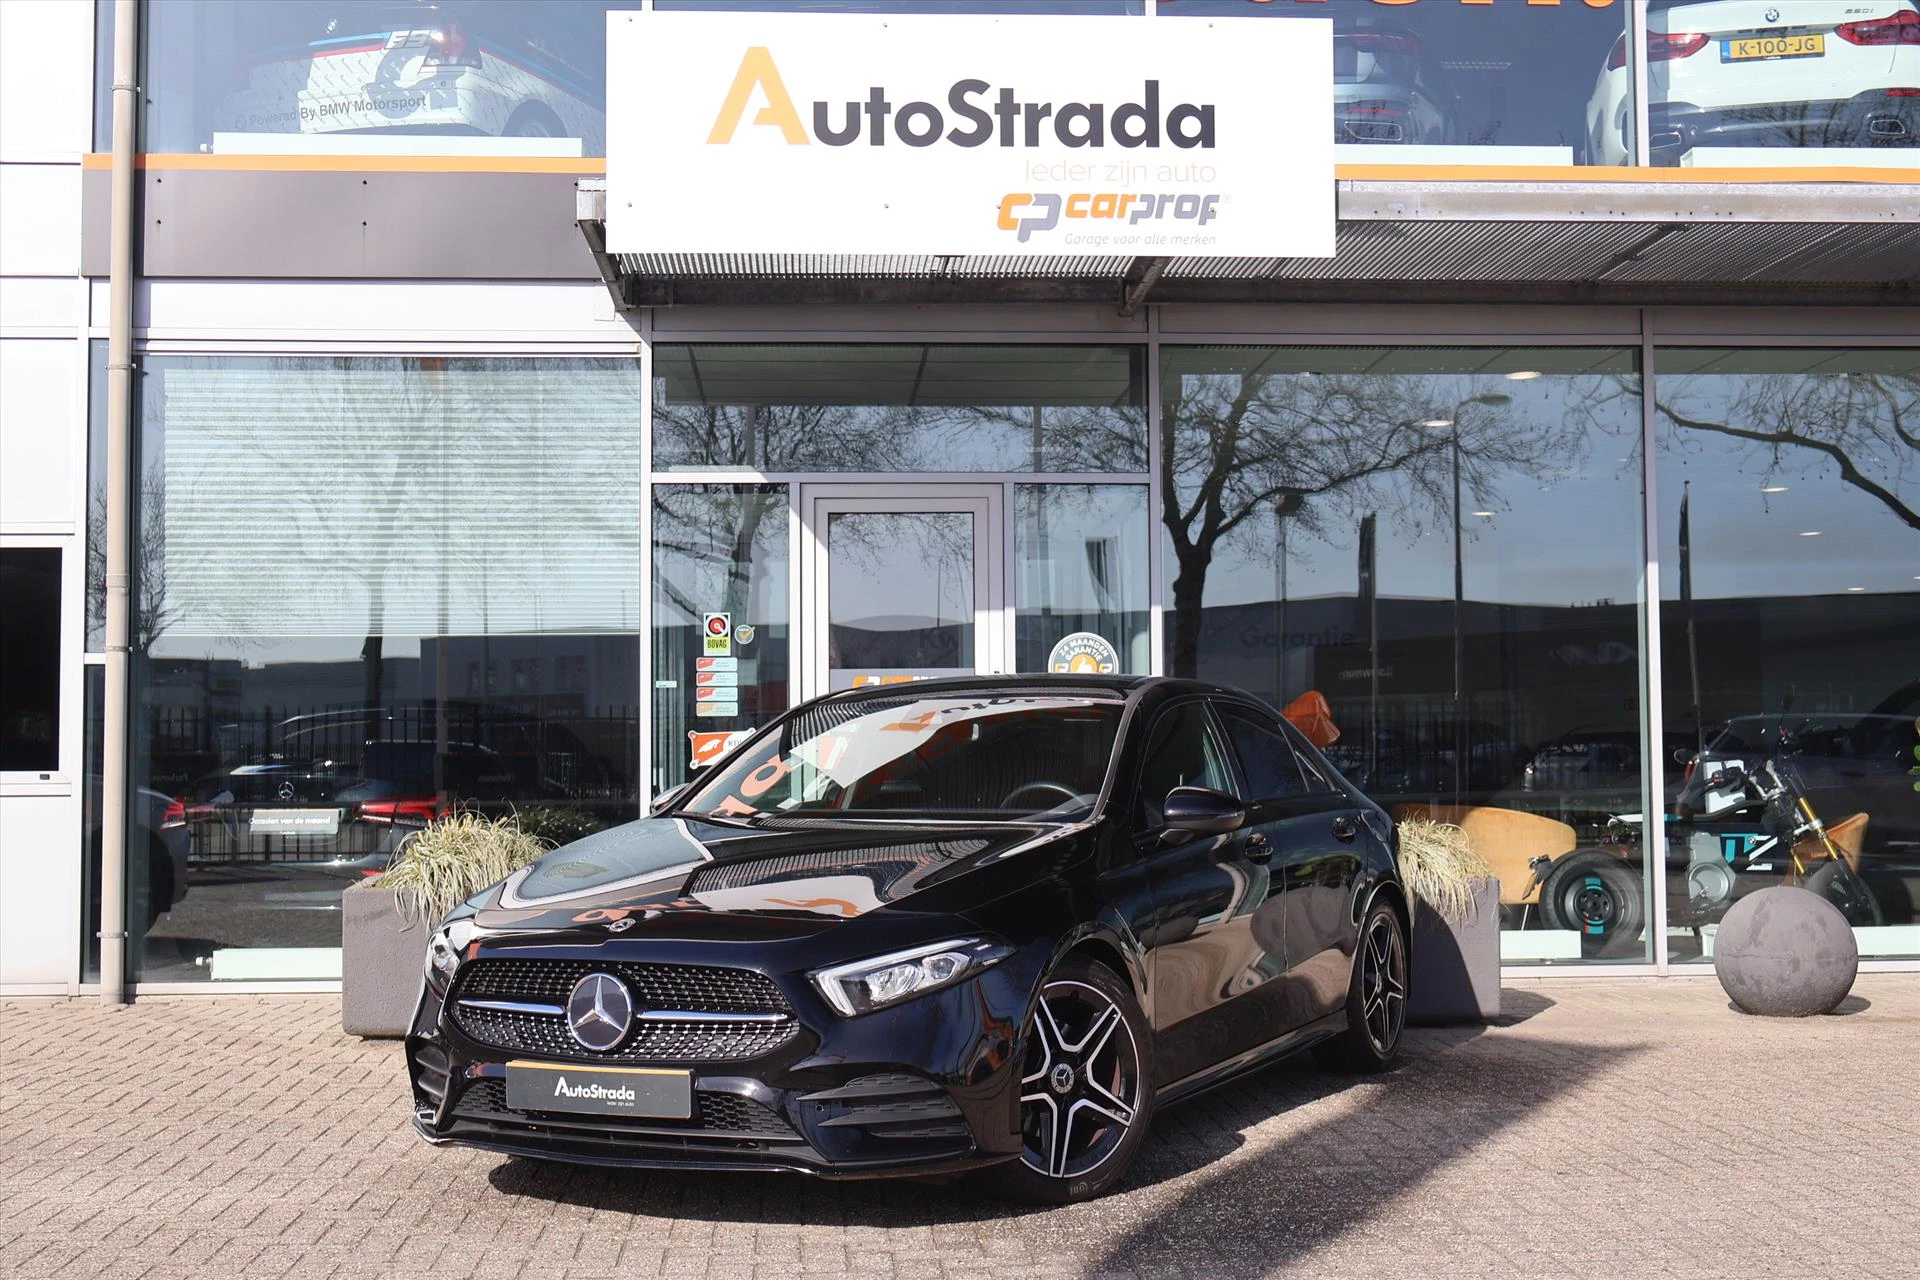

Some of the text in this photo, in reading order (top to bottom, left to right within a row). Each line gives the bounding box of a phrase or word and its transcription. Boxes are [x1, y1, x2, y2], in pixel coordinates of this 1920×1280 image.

[1738, 38, 1816, 56] K-100-JG
[708, 46, 1216, 149] AutoStrada
[250, 95, 427, 127] Powered By BMW Motorsport
[1025, 159, 1217, 188] Ieder zijn auto
[1064, 192, 1221, 226] carprof
[1064, 233, 1217, 248] Garage voor alle merken
[707, 638, 728, 650] BOVAG
[1239, 624, 1356, 648] Garantie
[1059, 638, 1110, 657] 24 MAANDEN
[1065, 645, 1104, 662] GARANTIE
[249, 816, 279, 825] Occasion
[294, 816, 304, 825] de
[305, 816, 331, 825] maand
[554, 1076, 636, 1101] AutoStrada
